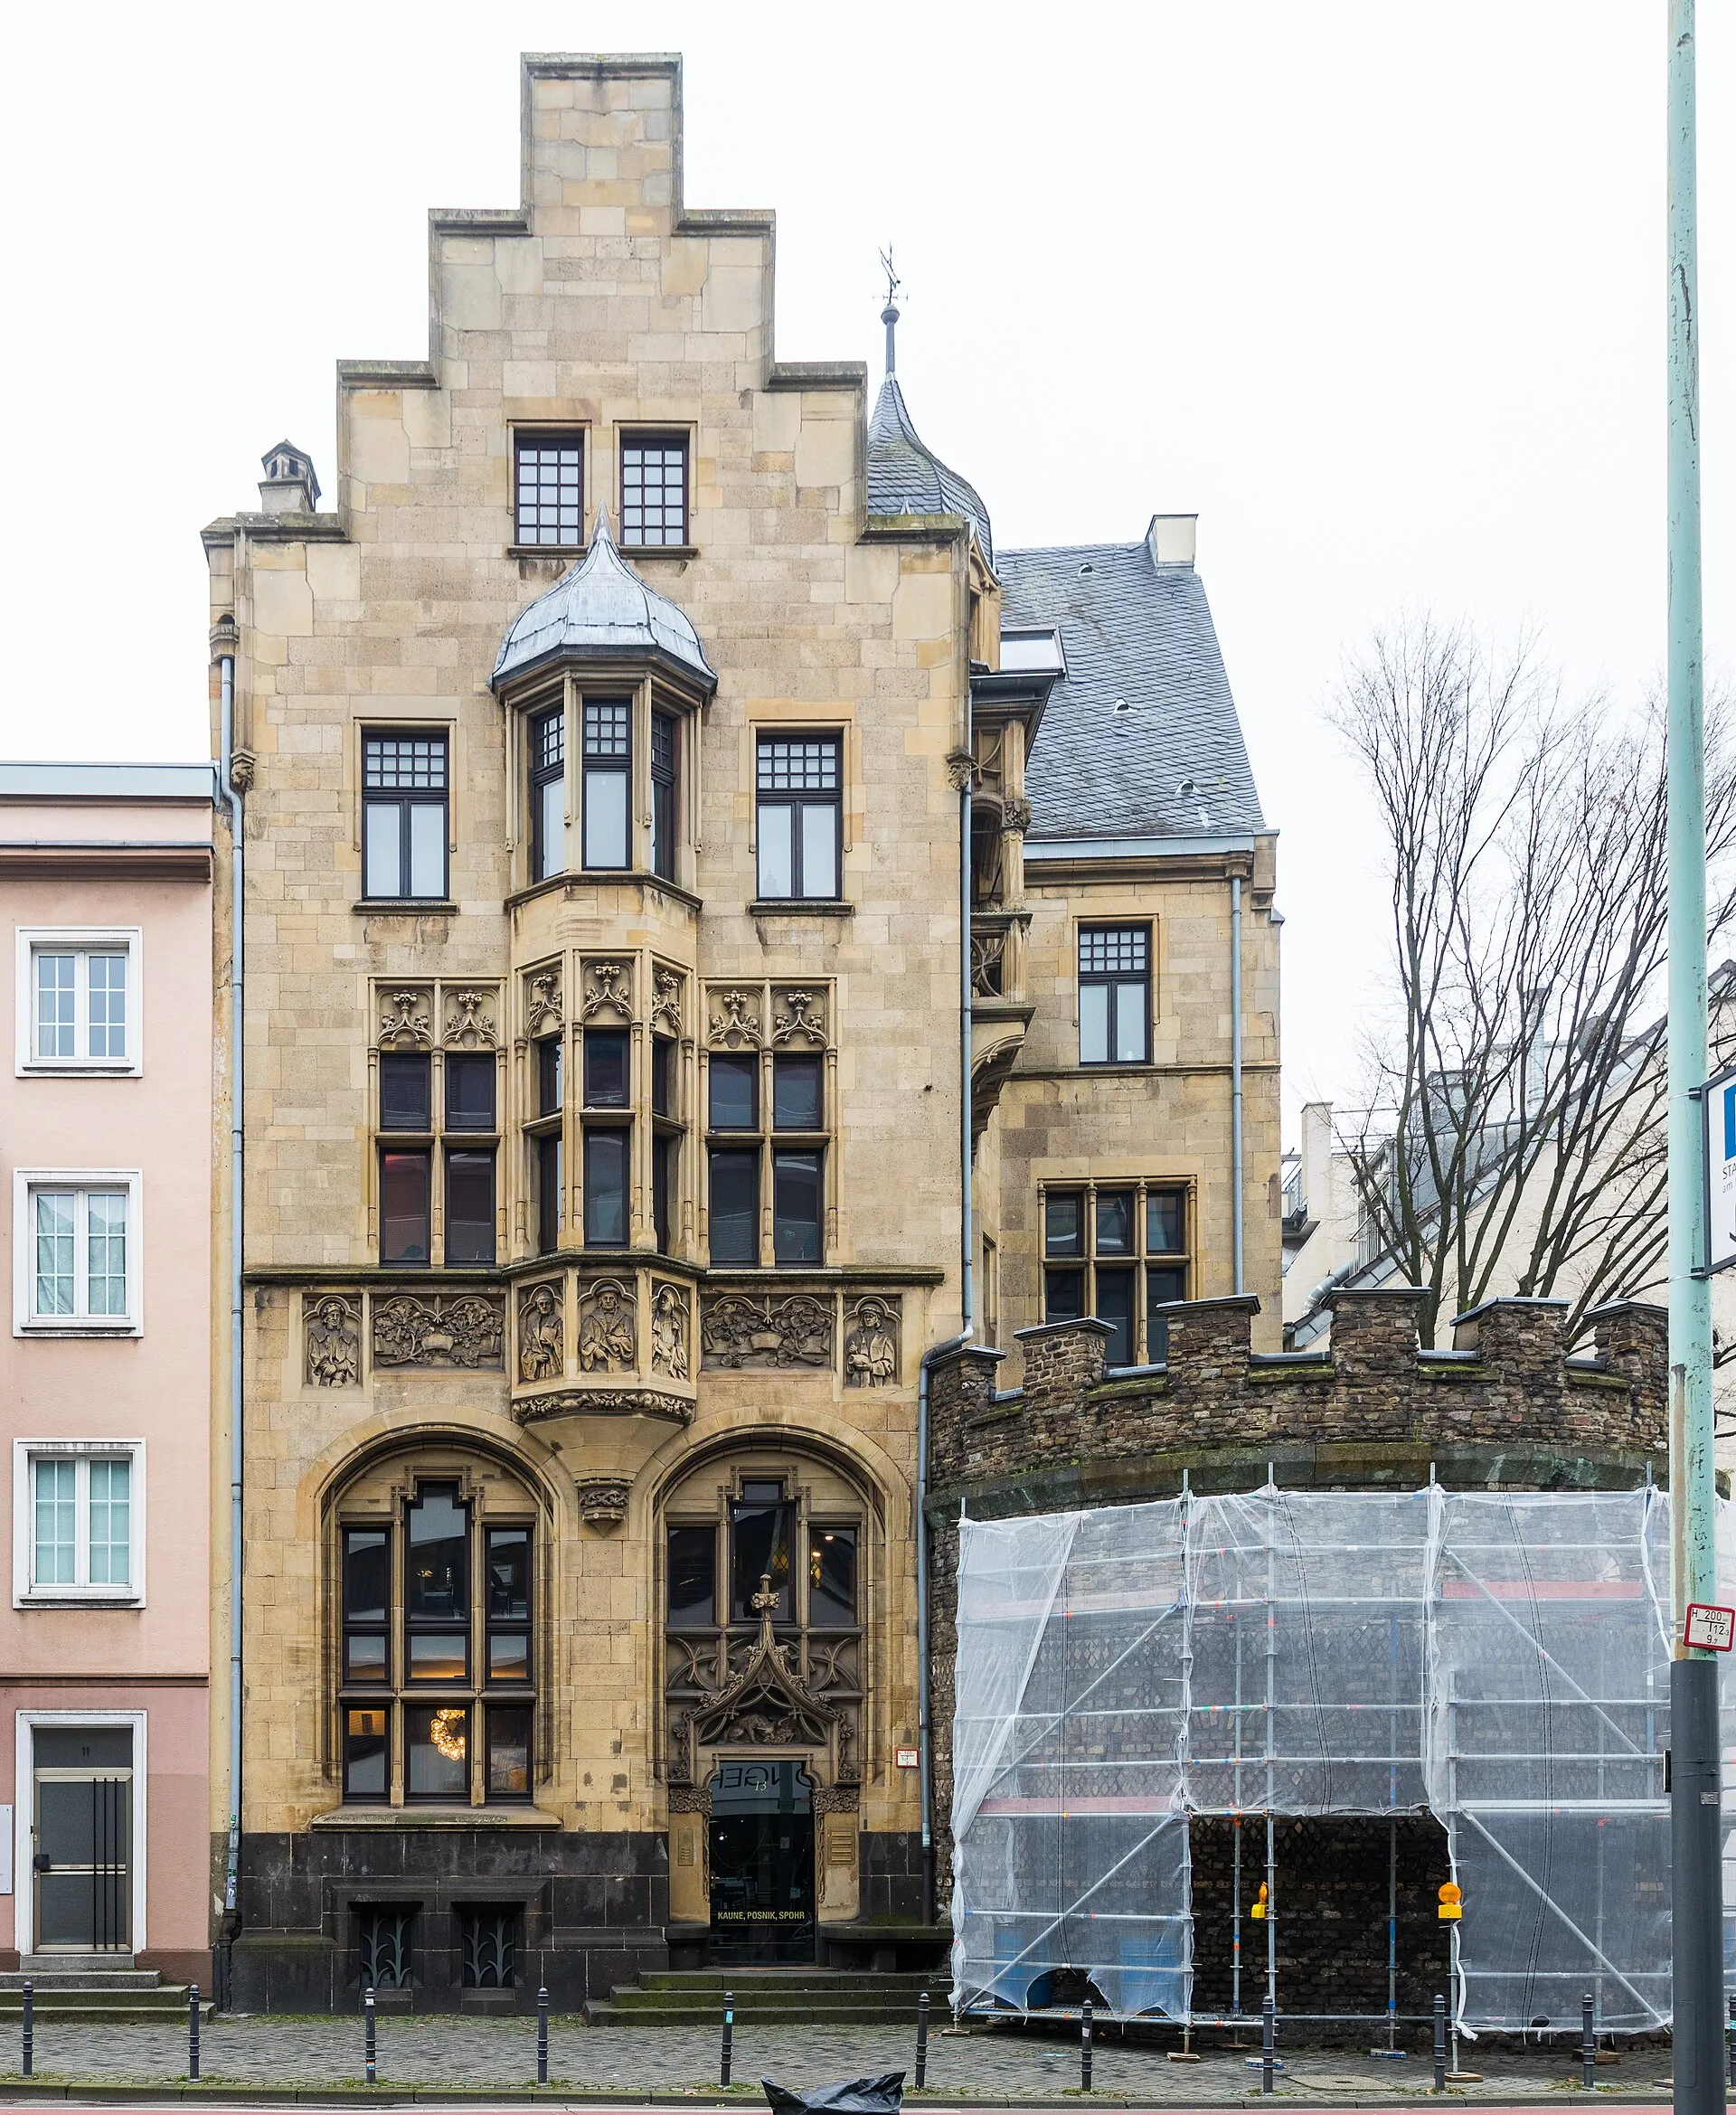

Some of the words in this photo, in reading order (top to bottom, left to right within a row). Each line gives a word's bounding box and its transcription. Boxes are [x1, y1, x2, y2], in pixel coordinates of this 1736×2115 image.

[1722, 1182, 1733, 1194] am
[1692, 1609, 1698, 1618] H
[1704, 1610, 1722, 1621] 200
[81, 1746, 90, 1756] 11
[754, 1780, 767, 1791] 13
[718, 1911, 746, 1921] KAUNE,
[747, 1911, 778, 1921] POSNIK,
[778, 1911, 805, 1920] SPOHR
